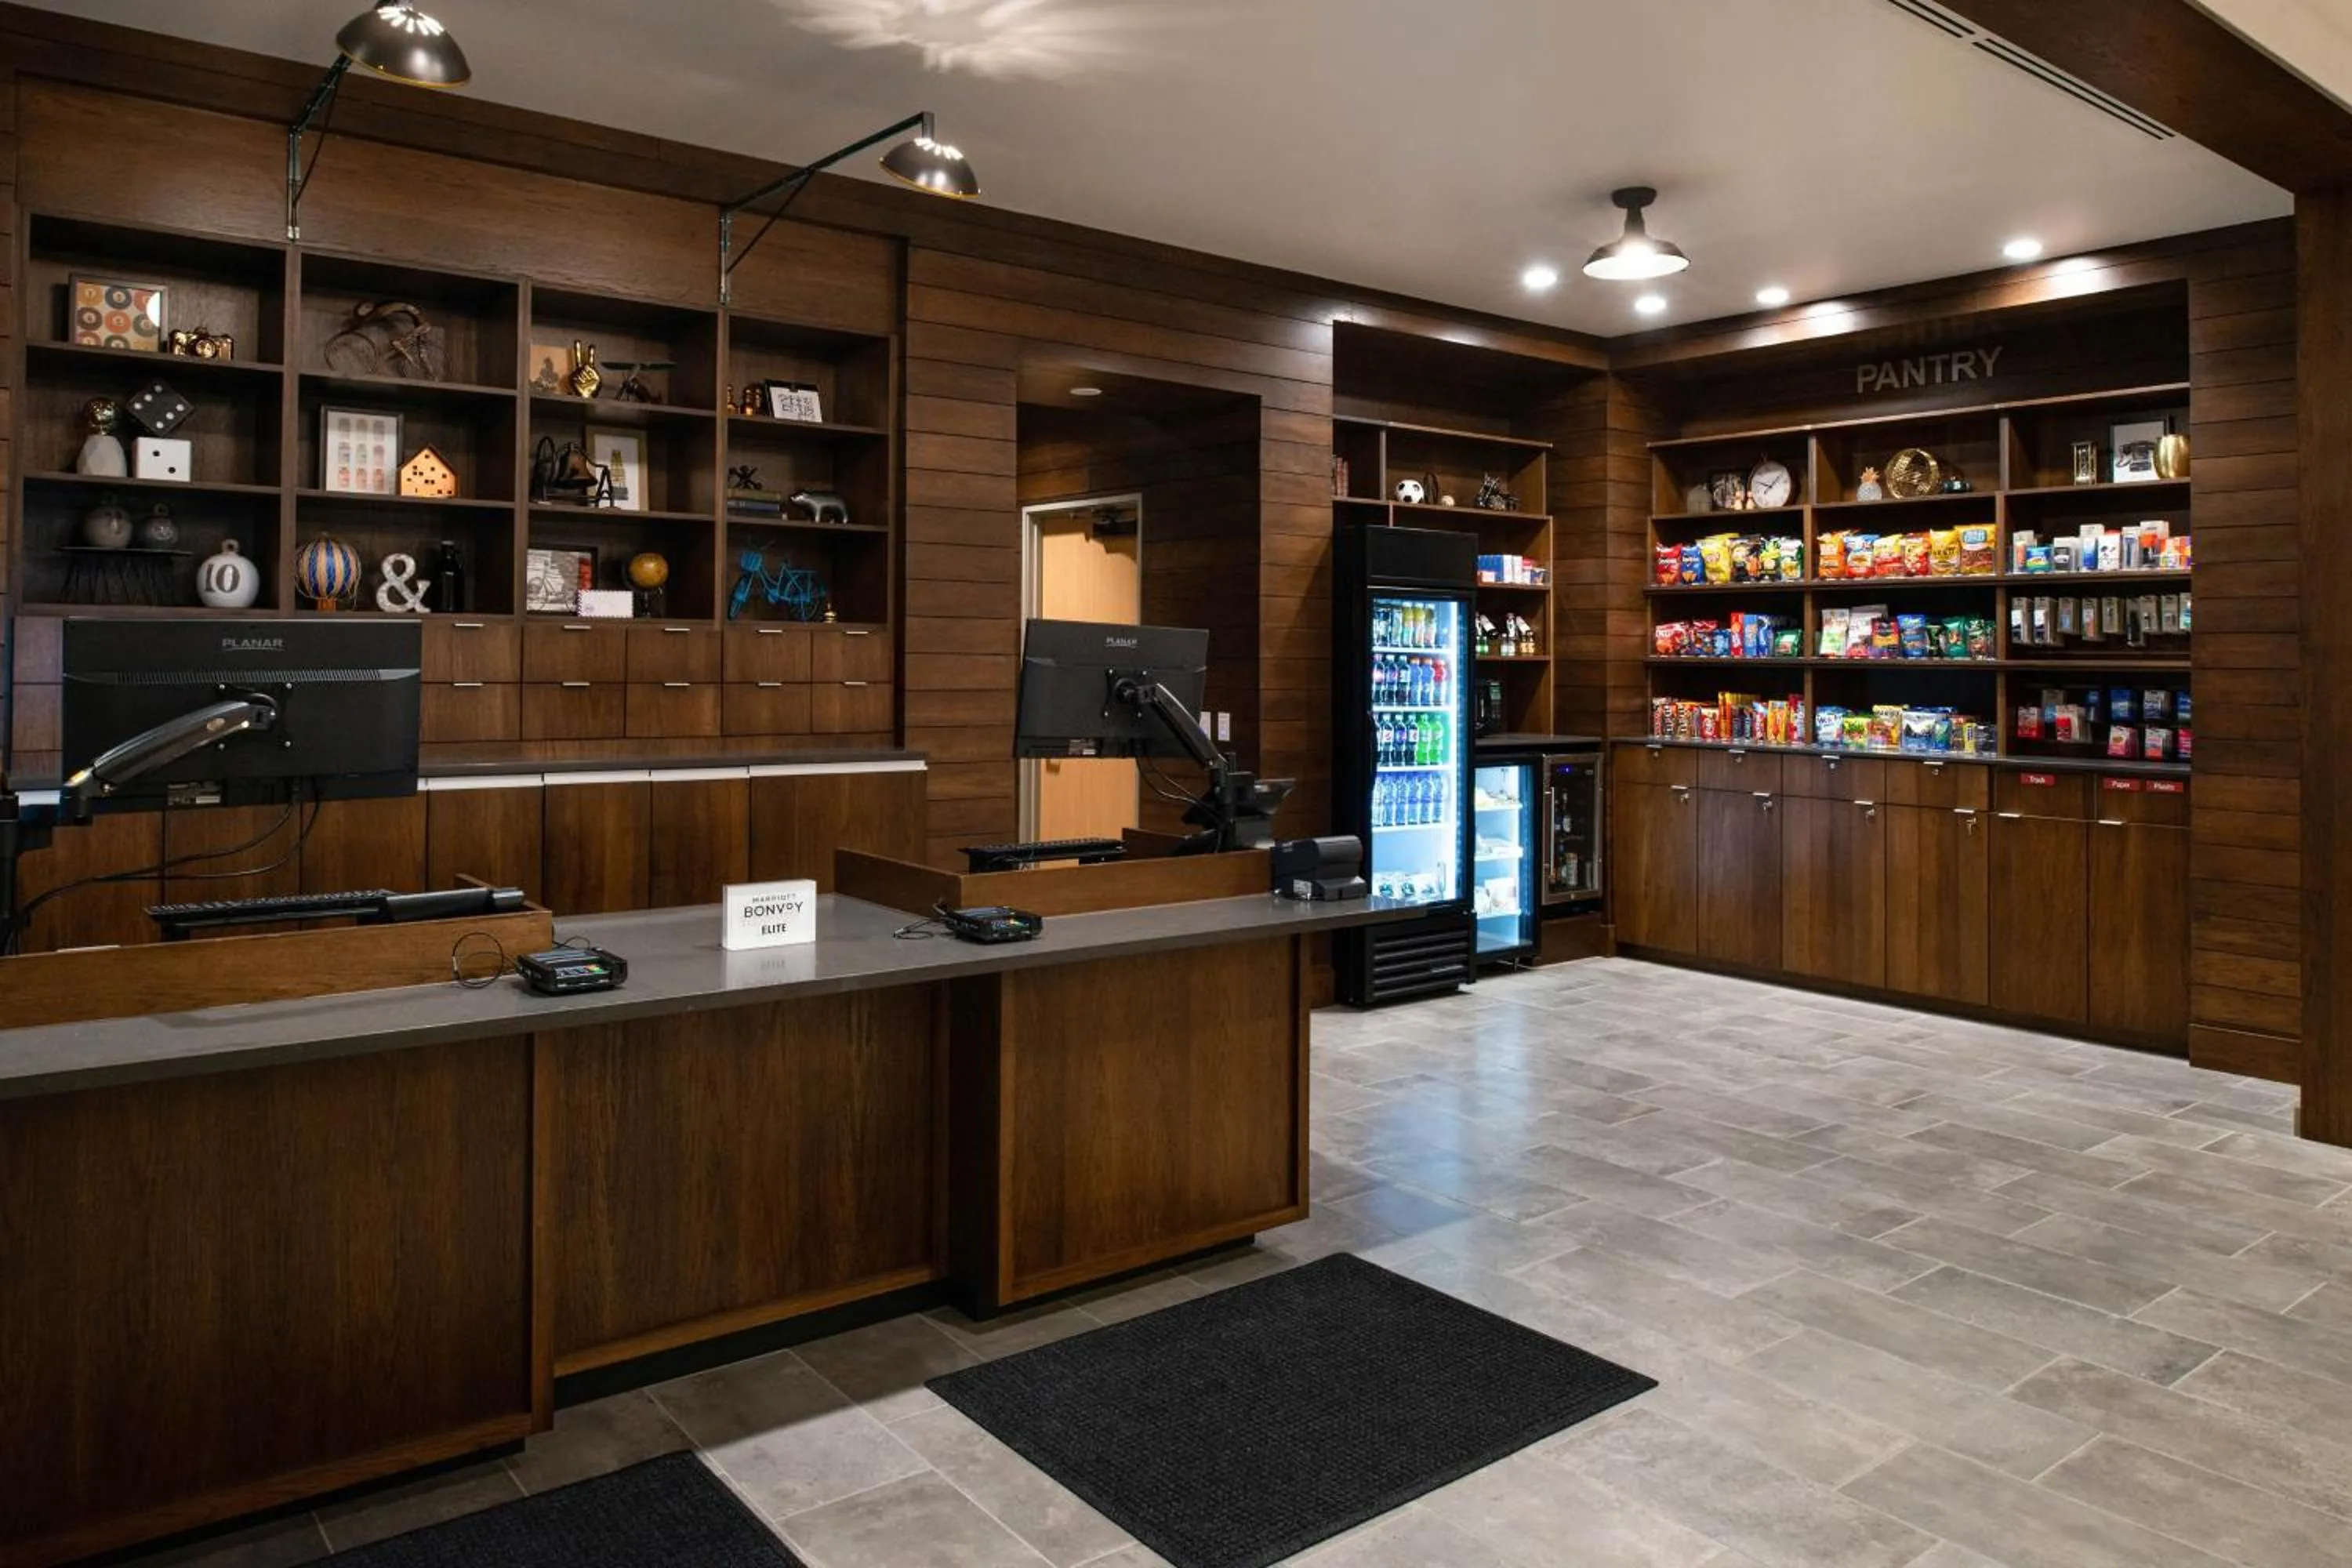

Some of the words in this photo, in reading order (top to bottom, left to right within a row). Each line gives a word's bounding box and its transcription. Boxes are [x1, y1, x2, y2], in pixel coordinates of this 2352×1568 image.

[1857, 346, 2003, 394] PANTRY
[205, 563, 241, 593] 10
[376, 553, 431, 612] &
[222, 638, 283, 648] PLANAR
[744, 902, 804, 918] BONVOY
[761, 924, 787, 935] ELITE
